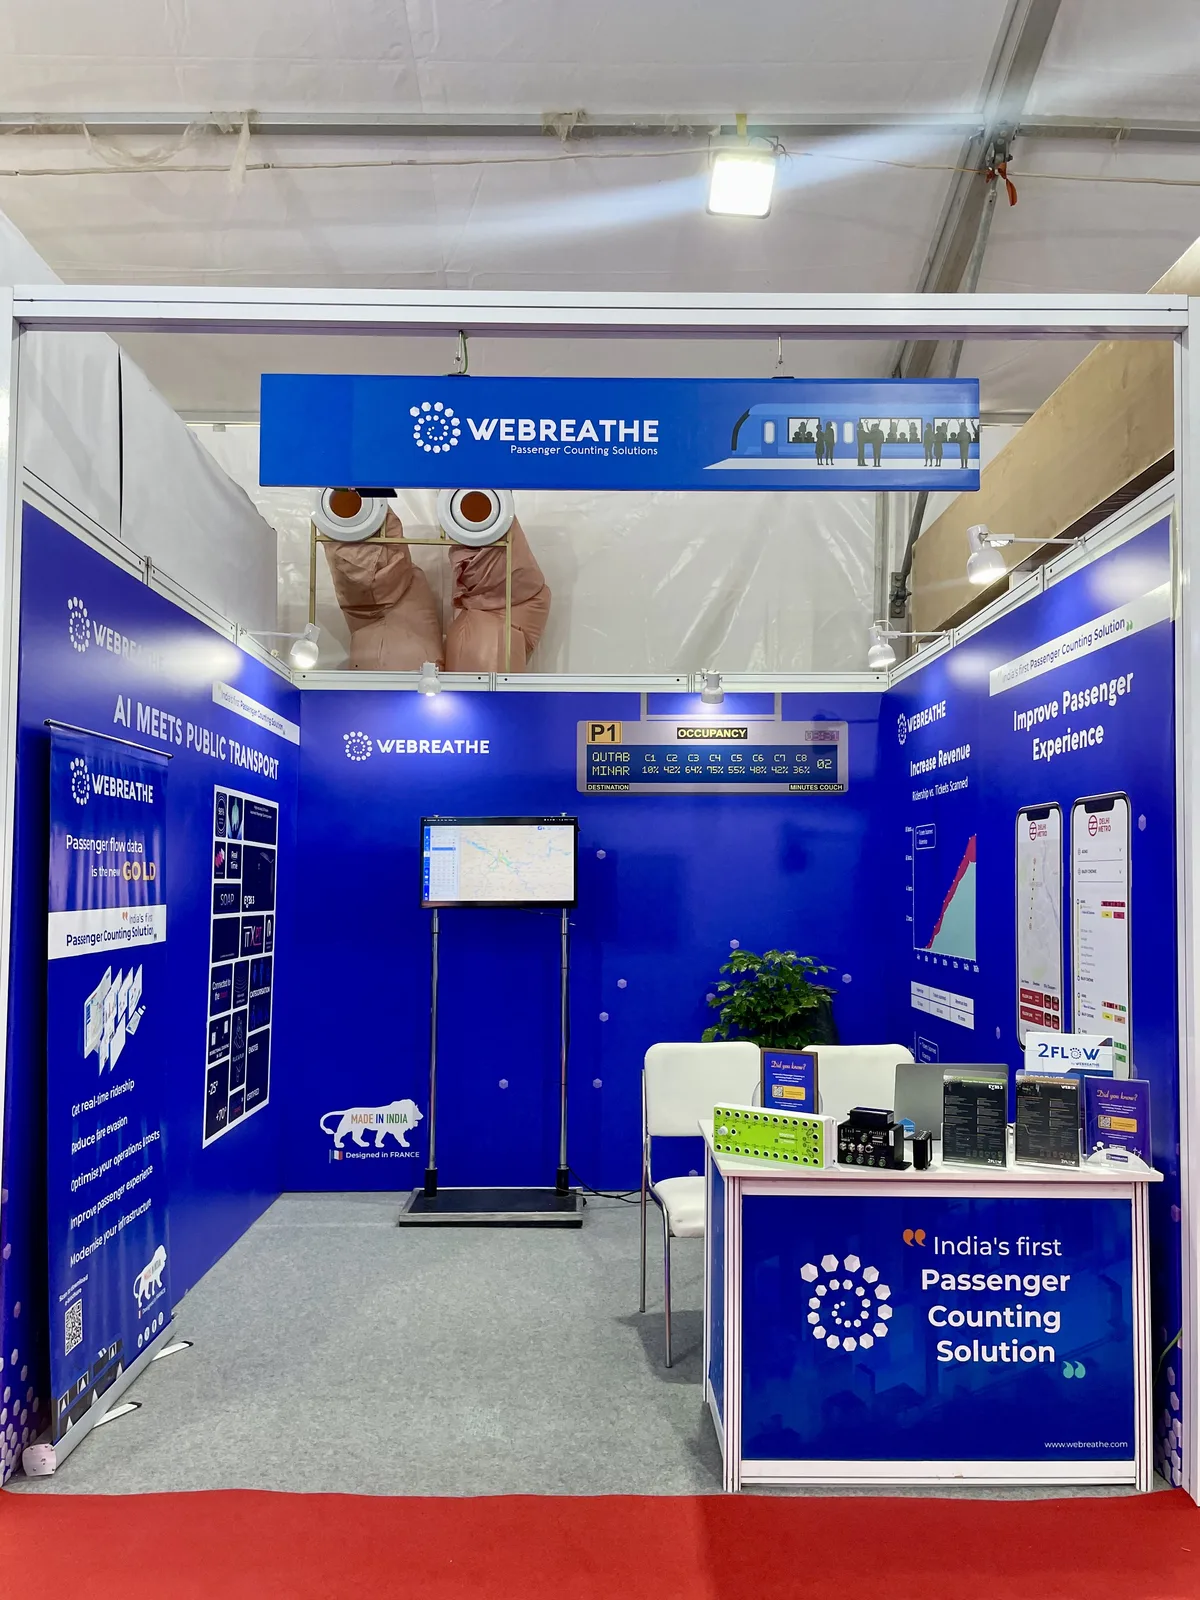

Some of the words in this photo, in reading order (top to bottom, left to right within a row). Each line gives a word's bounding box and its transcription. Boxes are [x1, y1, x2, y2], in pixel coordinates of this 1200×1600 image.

[467, 418, 659, 442] WEBREATHE
[510, 445, 561, 457] Passenger
[563, 445, 609, 456] Counting
[611, 445, 658, 456] Solutions
[1030, 648, 1061, 672] Passenger
[1061, 634, 1093, 656] Counting
[1094, 618, 1126, 641] Solution
[1013, 700, 1059, 732] Improve
[1062, 672, 1134, 715] Passenger
[907, 699, 946, 733] WEBREATHE
[113, 695, 131, 728] AI
[137, 702, 183, 745] MEETS
[187, 722, 226, 760] PUBLIC
[229, 740, 279, 780] TRANSPORT
[591, 723, 616, 742] P1
[678, 729, 747, 739] OCCUPANCY
[1032, 724, 1105, 762] Experience
[376, 739, 490, 754] WEBREATHE
[592, 752, 630, 763] QUTAB
[644, 753, 656, 763] C1
[666, 753, 678, 763] C2
[688, 753, 700, 763] C3
[709, 753, 721, 763] C4
[731, 753, 743, 763] C5
[752, 753, 764, 763] C6
[774, 753, 786, 763] C7
[795, 753, 808, 763] C8
[816, 759, 832, 769] 02
[592, 765, 630, 776] MINAR
[642, 765, 659, 774] 10%
[663, 765, 680, 774] 42%
[685, 765, 702, 774] 64%
[706, 765, 724, 774] 75%
[728, 765, 745, 774] 55%
[750, 765, 767, 774] 48%
[771, 765, 788, 774] 42%
[793, 765, 810, 774] 36%
[910, 755, 937, 777] Increase
[938, 743, 971, 768] Revenue
[92, 773, 153, 804] WEBREATHE
[935, 781, 949, 795] Tickets
[949, 776, 969, 792] Scanned
[66, 835, 108, 854] Passenger
[109, 837, 126, 852] flow
[126, 839, 143, 853] data
[91, 865, 98, 877] is
[98, 865, 108, 877] the
[108, 867, 121, 877] new
[122, 860, 156, 881] GOLD
[66, 930, 103, 946] Passenger
[103, 928, 131, 942] Counting
[1037, 1043, 1100, 1061] 2FLOW
[71, 1103, 81, 1118] Get
[81, 1091, 109, 1112] real-time
[109, 1079, 135, 1098] ridership
[1096, 1089, 1110, 1098] Did
[1120, 1092, 1138, 1102] know?
[351, 1113, 374, 1124] MADE
[375, 1113, 384, 1124] IN
[386, 1113, 408, 1124] INDIA
[71, 1135, 95, 1155] Reduce
[106, 1116, 128, 1134] evasion
[70, 1166, 99, 1192] Optimise
[99, 1158, 112, 1178] your
[113, 1141, 143, 1166] operations
[345, 1151, 380, 1160] Designed
[70, 1204, 97, 1230] Improve
[96, 1184, 125, 1211] passenger
[125, 1163, 153, 1190] experience
[69, 1237, 103, 1268] Modernise
[103, 1226, 117, 1245] your
[117, 1198, 152, 1230] infrastructure
[934, 1235, 1010, 1257] India's
[1015, 1236, 1062, 1257] first
[921, 1268, 1070, 1297] Passenger
[928, 1304, 1062, 1334] Counting
[936, 1339, 1055, 1363] Solution
[1044, 1440, 1128, 1449] www.webreathe.com
